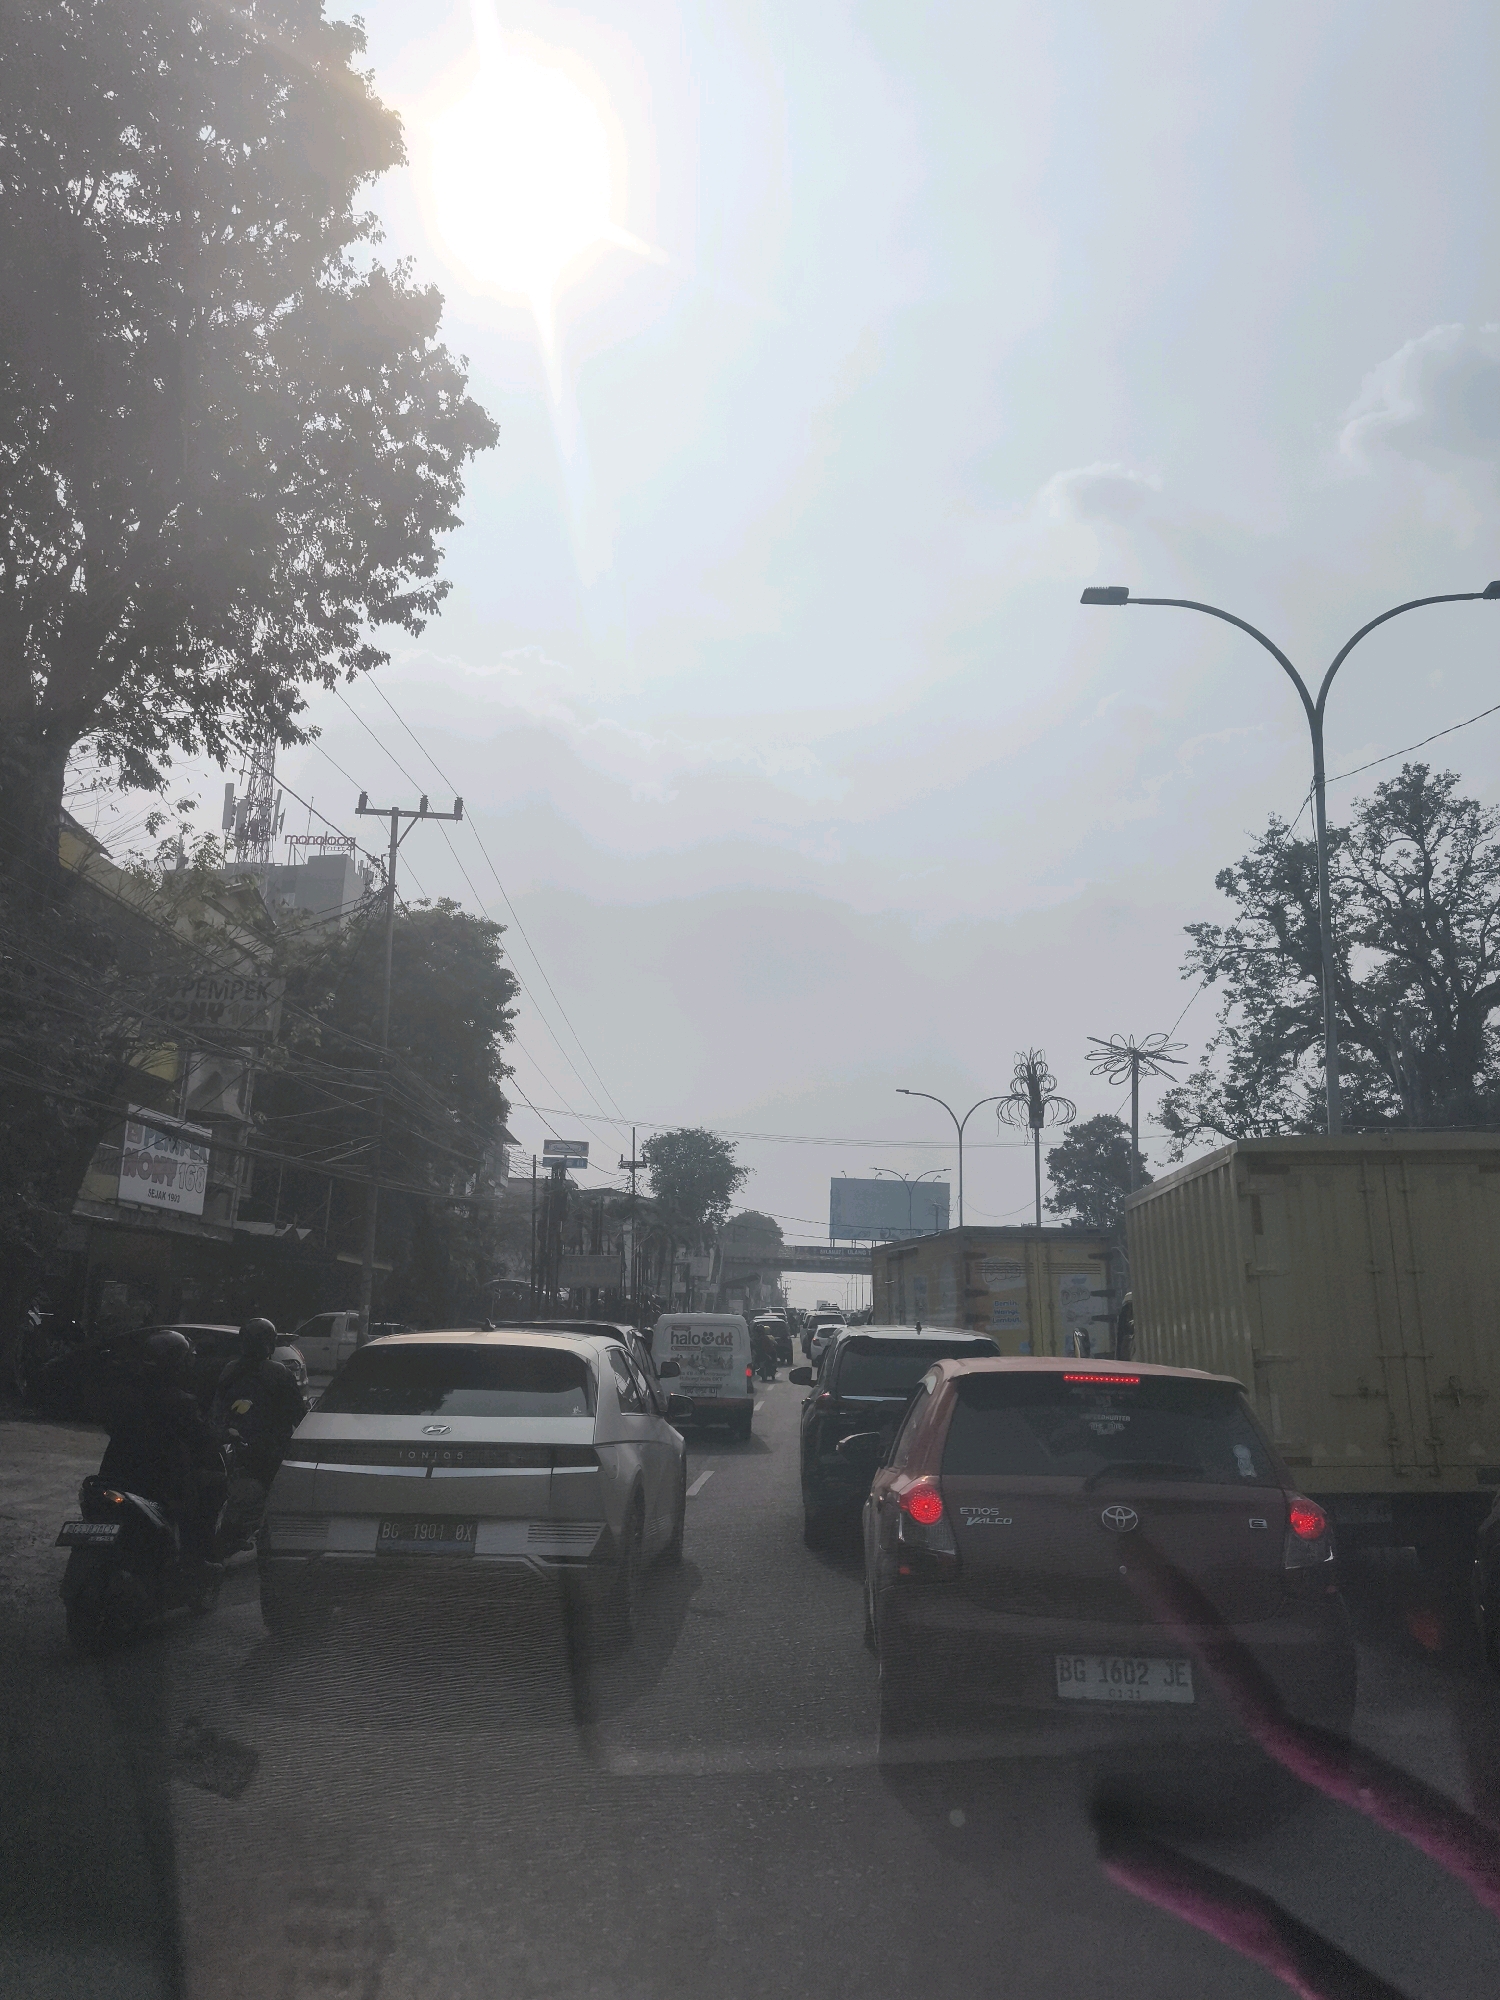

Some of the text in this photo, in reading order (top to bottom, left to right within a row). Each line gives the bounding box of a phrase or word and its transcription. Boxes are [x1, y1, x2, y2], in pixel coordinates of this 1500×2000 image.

[123, 1147, 206, 1194] NONY 168
[147, 1188, 167, 1200] SEJAK
[671, 1331, 733, 1346] halo dkt
[457, 1451, 464, 1460] 5
[960, 1507, 1000, 1516] ETIOS
[966, 1516, 1013, 1526] VALCO
[382, 1521, 400, 1539] BG
[414, 1523, 445, 1540] 1901
[1059, 1658, 1189, 1687] BG 1602 JE
